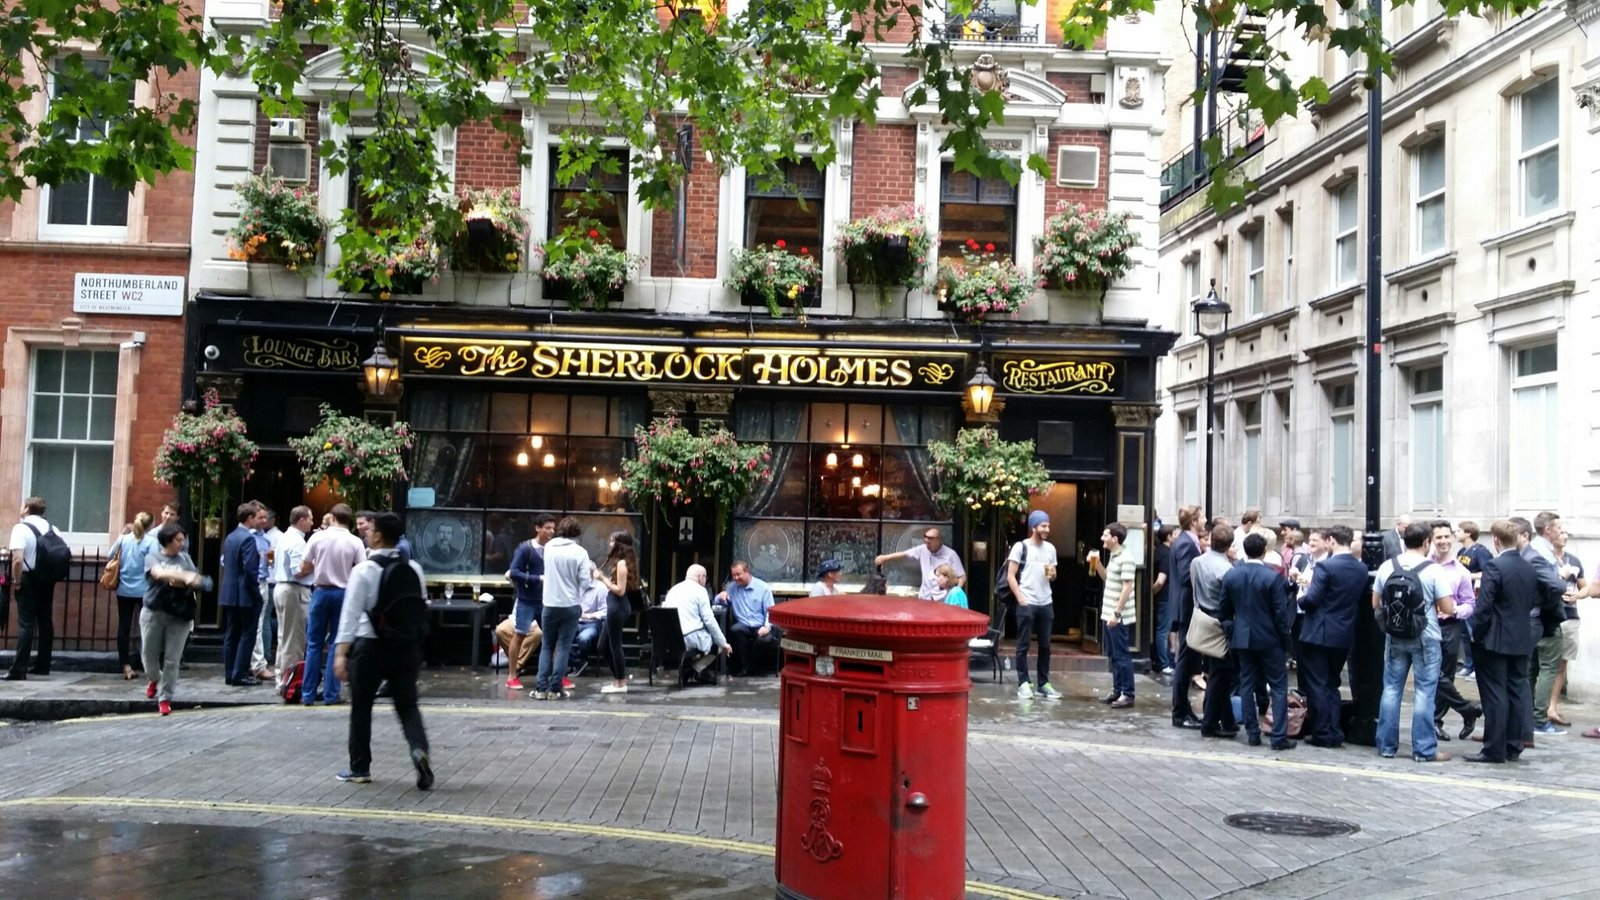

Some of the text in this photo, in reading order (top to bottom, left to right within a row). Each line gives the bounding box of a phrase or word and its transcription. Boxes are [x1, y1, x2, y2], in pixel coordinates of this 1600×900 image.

[80, 277, 178, 290] NORTHUMBERLAND
[80, 289, 144, 301] STREET WC2
[251, 336, 353, 368] LOUNGE BAR
[457, 344, 913, 387] The SHERLOCK HOLMES
[1008, 363, 1108, 388] RESTAURANT
[1367, 475, 1374, 485] 3
[835, 648, 884, 659] FRANKED MAIL
